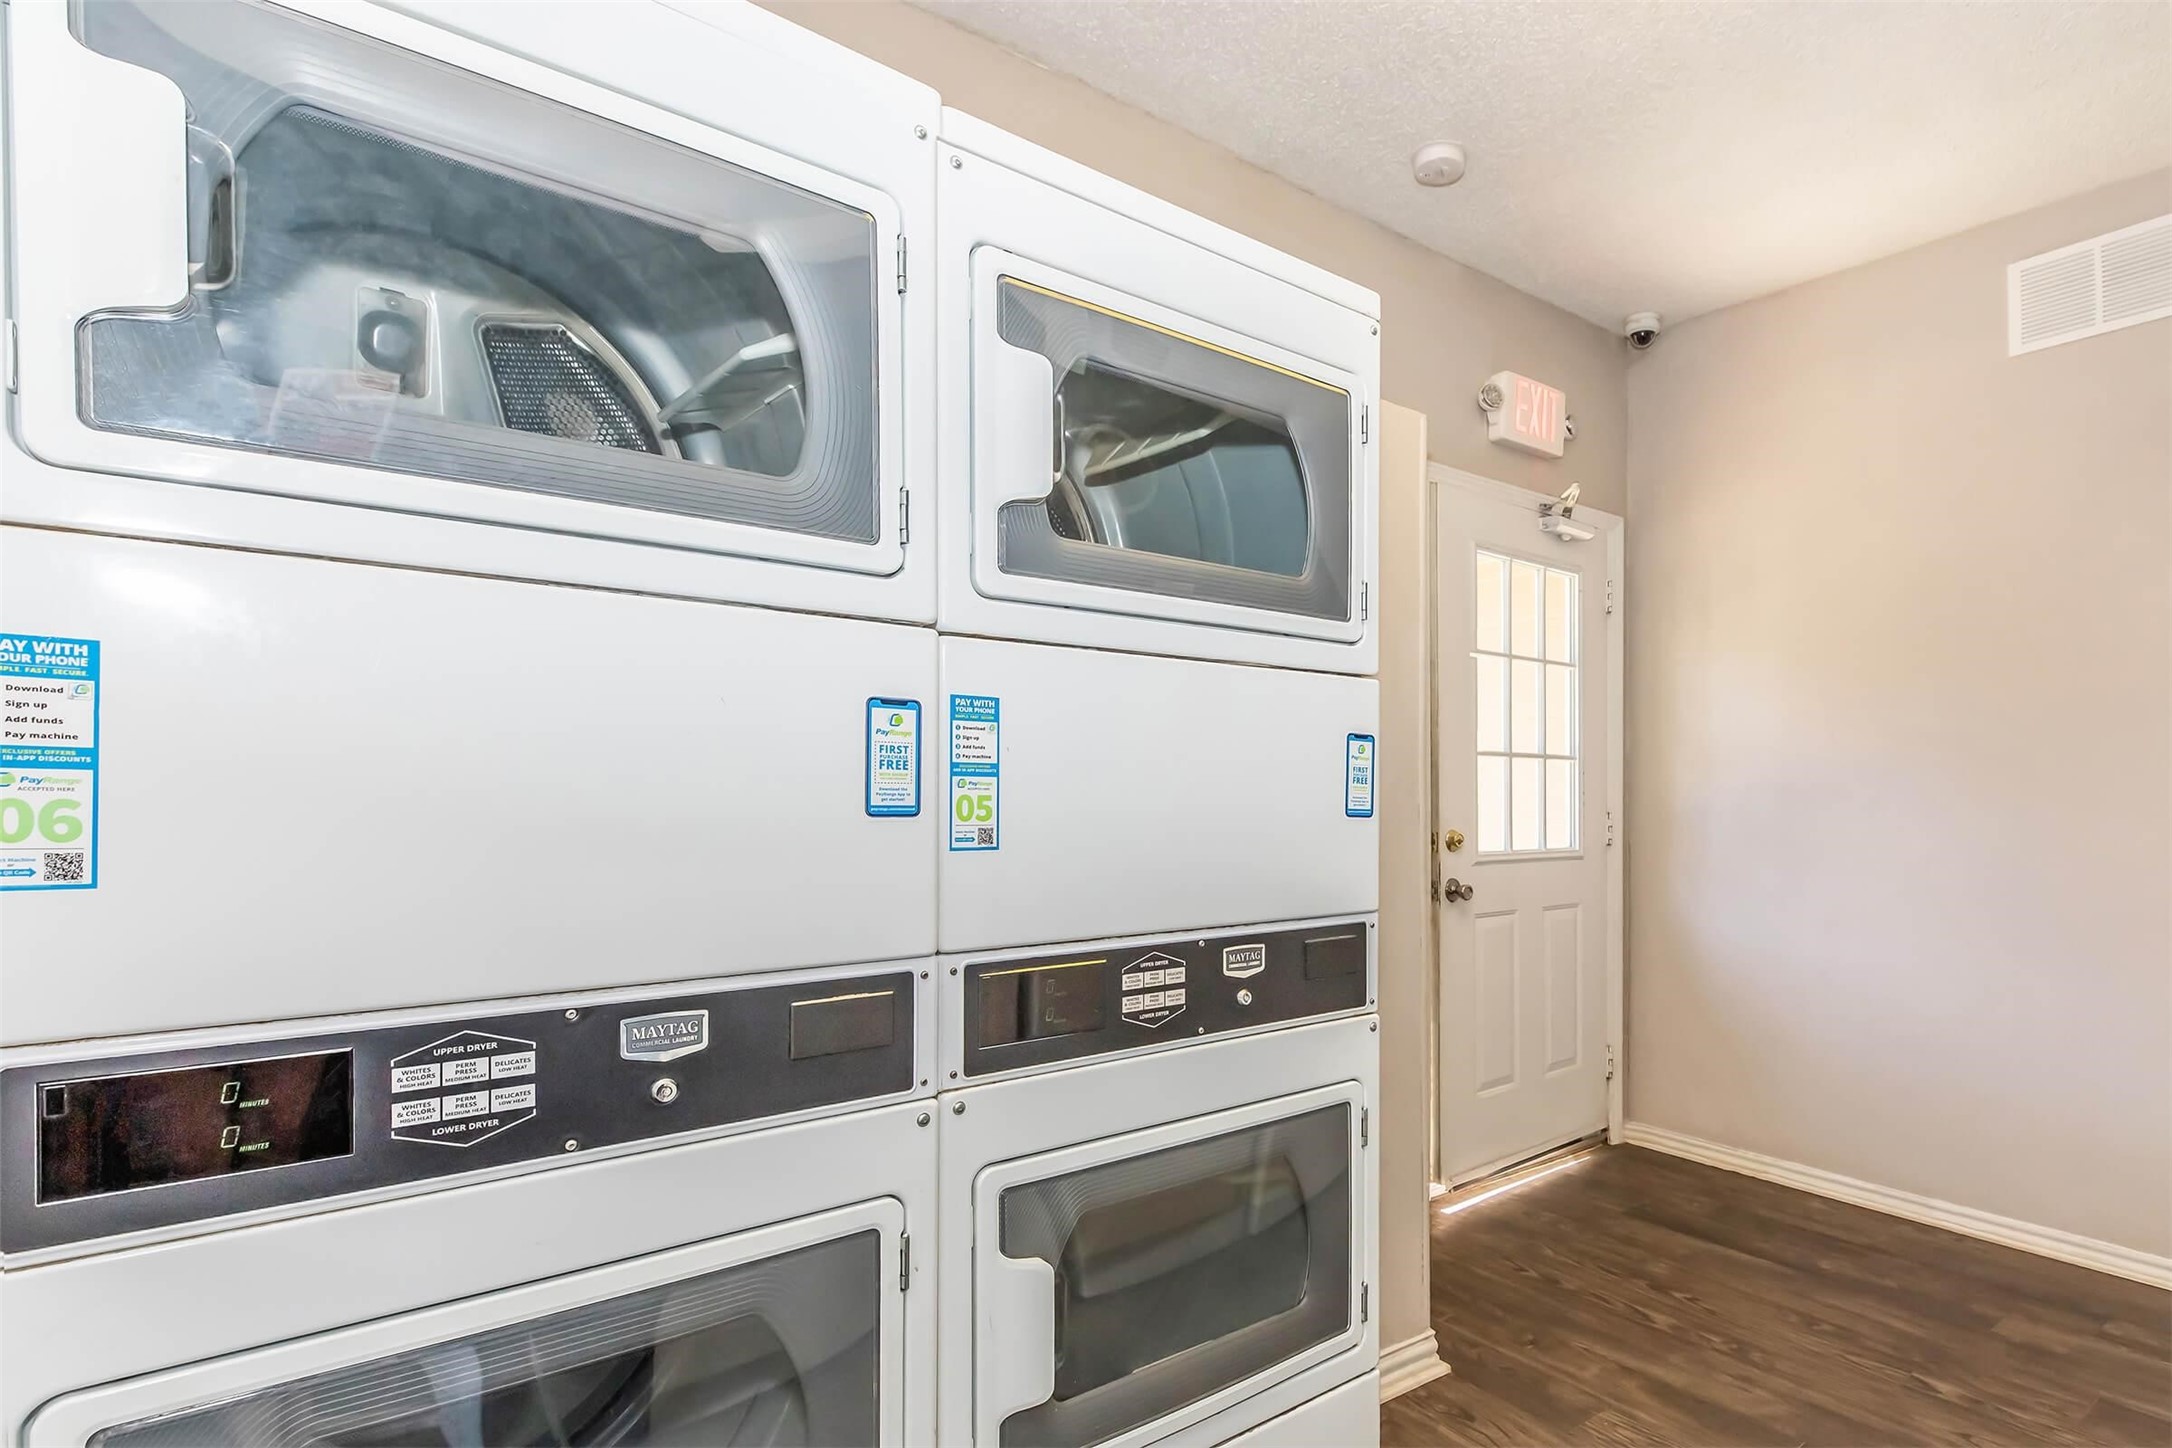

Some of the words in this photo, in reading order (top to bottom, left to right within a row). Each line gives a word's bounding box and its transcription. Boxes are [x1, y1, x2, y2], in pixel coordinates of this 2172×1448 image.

[1516, 379, 1559, 442] EXIT
[0, 639, 28, 652] AY
[32, 641, 88, 656] WITH
[0, 652, 32, 664] OUR
[35, 654, 88, 667] PHONE
[5, 684, 64, 694] Download
[5, 700, 30, 709] Sign
[955, 698, 971, 706] PAY
[972, 699, 995, 708] WITH
[31, 716, 64, 724] funds
[4, 731, 26, 740] Pay
[30, 732, 79, 740] machine
[876, 728, 912, 738] PayRange
[879, 745, 910, 754] FIRST
[879, 760, 908, 770] FREE
[20, 776, 82, 785] PayRange
[956, 794, 993, 822] 05
[0, 798, 83, 844] 06
[1228, 950, 1260, 963] MAYTAG
[632, 1020, 698, 1040] MAYTAG
[632, 1038, 670, 1048] COMMERCIAL
[672, 1035, 698, 1044] LAUNDRY
[433, 1045, 465, 1056] UPPER
[467, 1042, 498, 1053] DRYER
[494, 1057, 531, 1067] DELICATES
[401, 1067, 432, 1076] WHITES
[406, 1073, 436, 1082] COLORS
[220, 1082, 241, 1104] 0
[239, 1098, 270, 1108] MINUTES
[494, 1090, 531, 1100] DELICATES
[402, 1102, 432, 1110] WHITES
[406, 1108, 436, 1117] COLORS
[432, 1124, 466, 1136] LOWER
[468, 1119, 500, 1130] DRYER
[220, 1126, 241, 1148] 0
[239, 1142, 270, 1152] MINUTES
